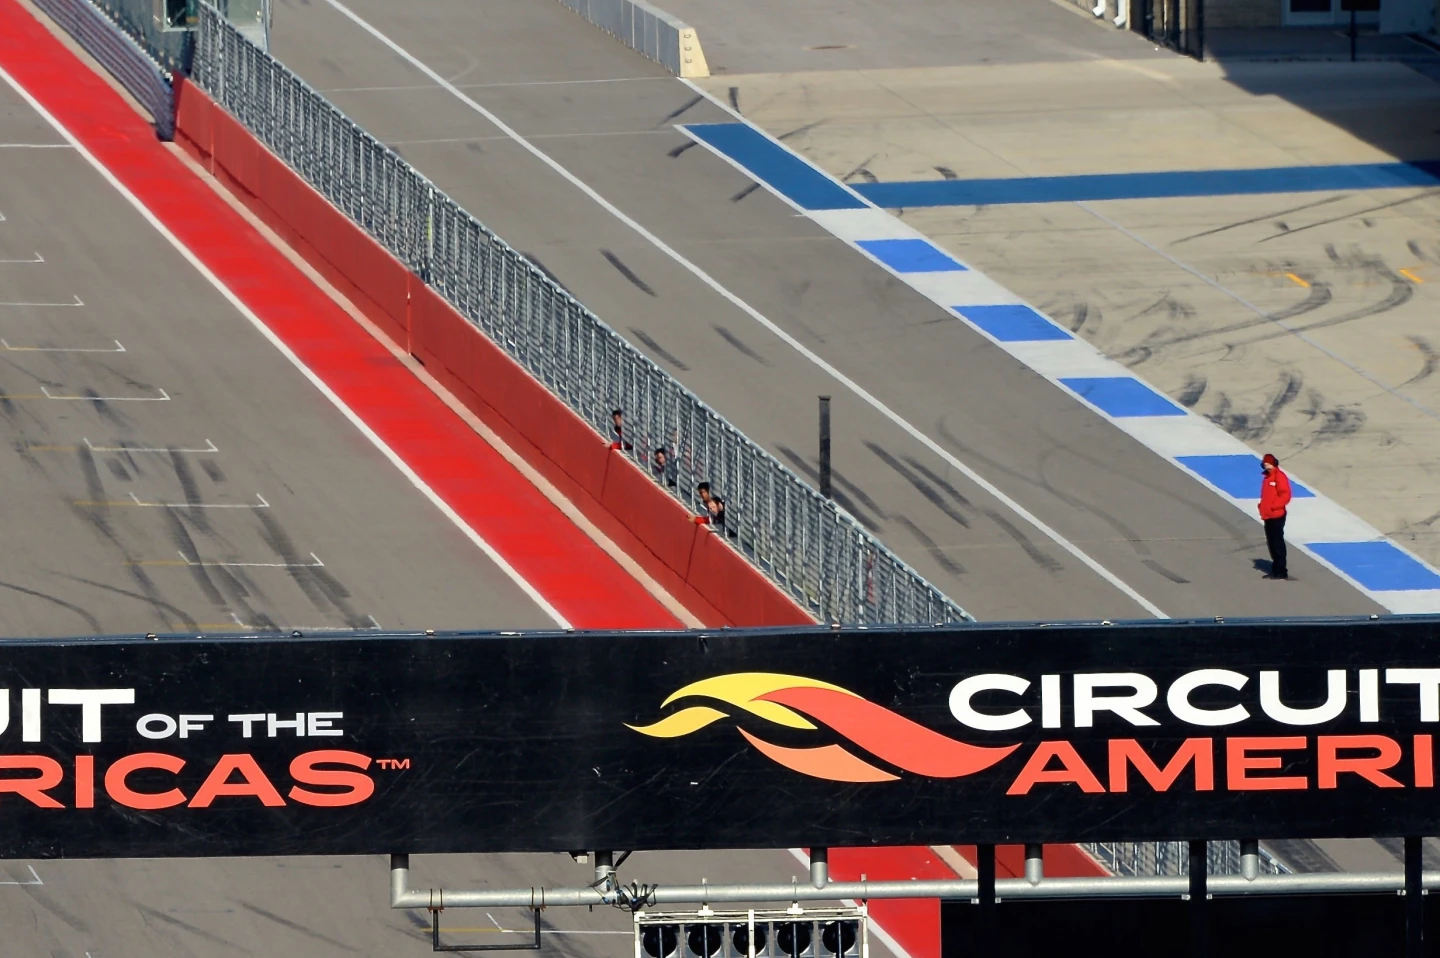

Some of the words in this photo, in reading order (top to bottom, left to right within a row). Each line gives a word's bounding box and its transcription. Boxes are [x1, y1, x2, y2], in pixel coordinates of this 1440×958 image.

[136, 714, 213, 739] OF
[228, 712, 343, 738] THE
[949, 668, 1440, 731] CIRCUIT
[1006, 735, 1434, 795] AMERI
